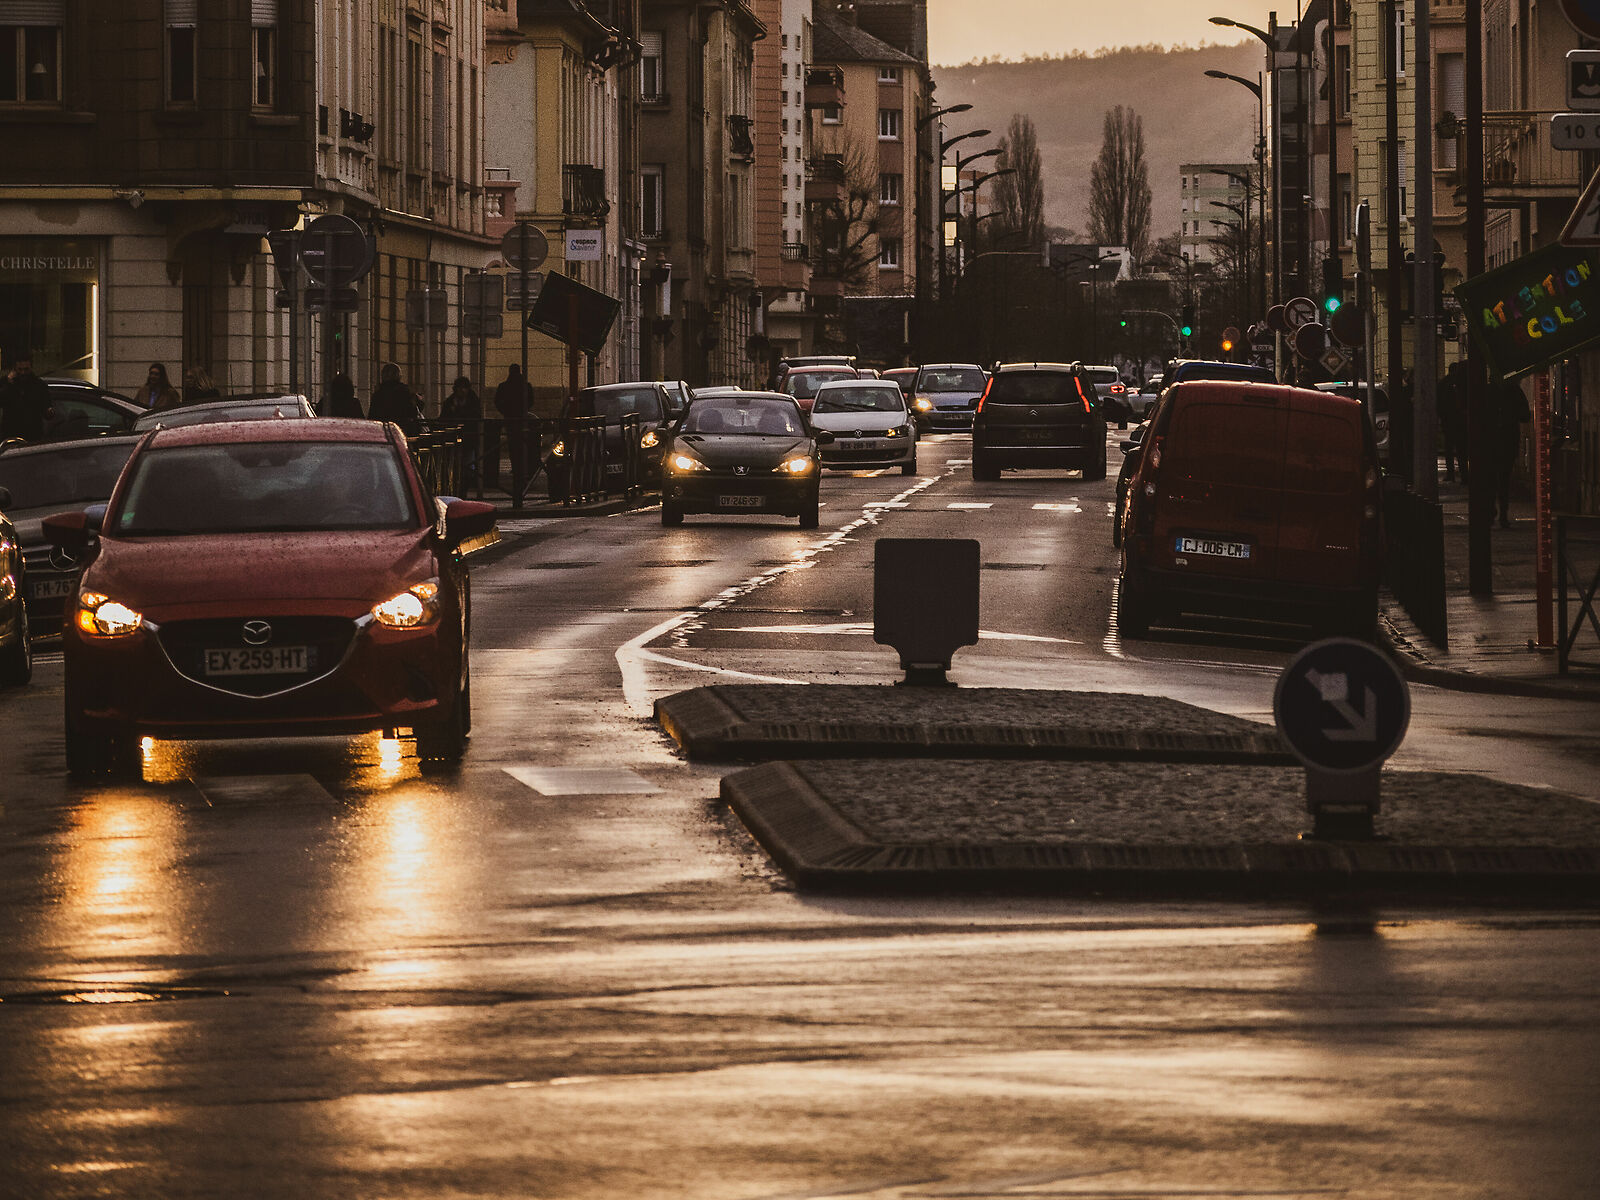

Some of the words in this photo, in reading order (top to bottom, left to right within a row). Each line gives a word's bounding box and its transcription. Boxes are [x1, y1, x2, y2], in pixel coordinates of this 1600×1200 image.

[1564, 124, 1586, 139] 10
[1, 255, 96, 270] CHRISTELLE
[1482, 259, 1592, 329] ATTENTION
[208, 648, 305, 671] EX-259-HT
